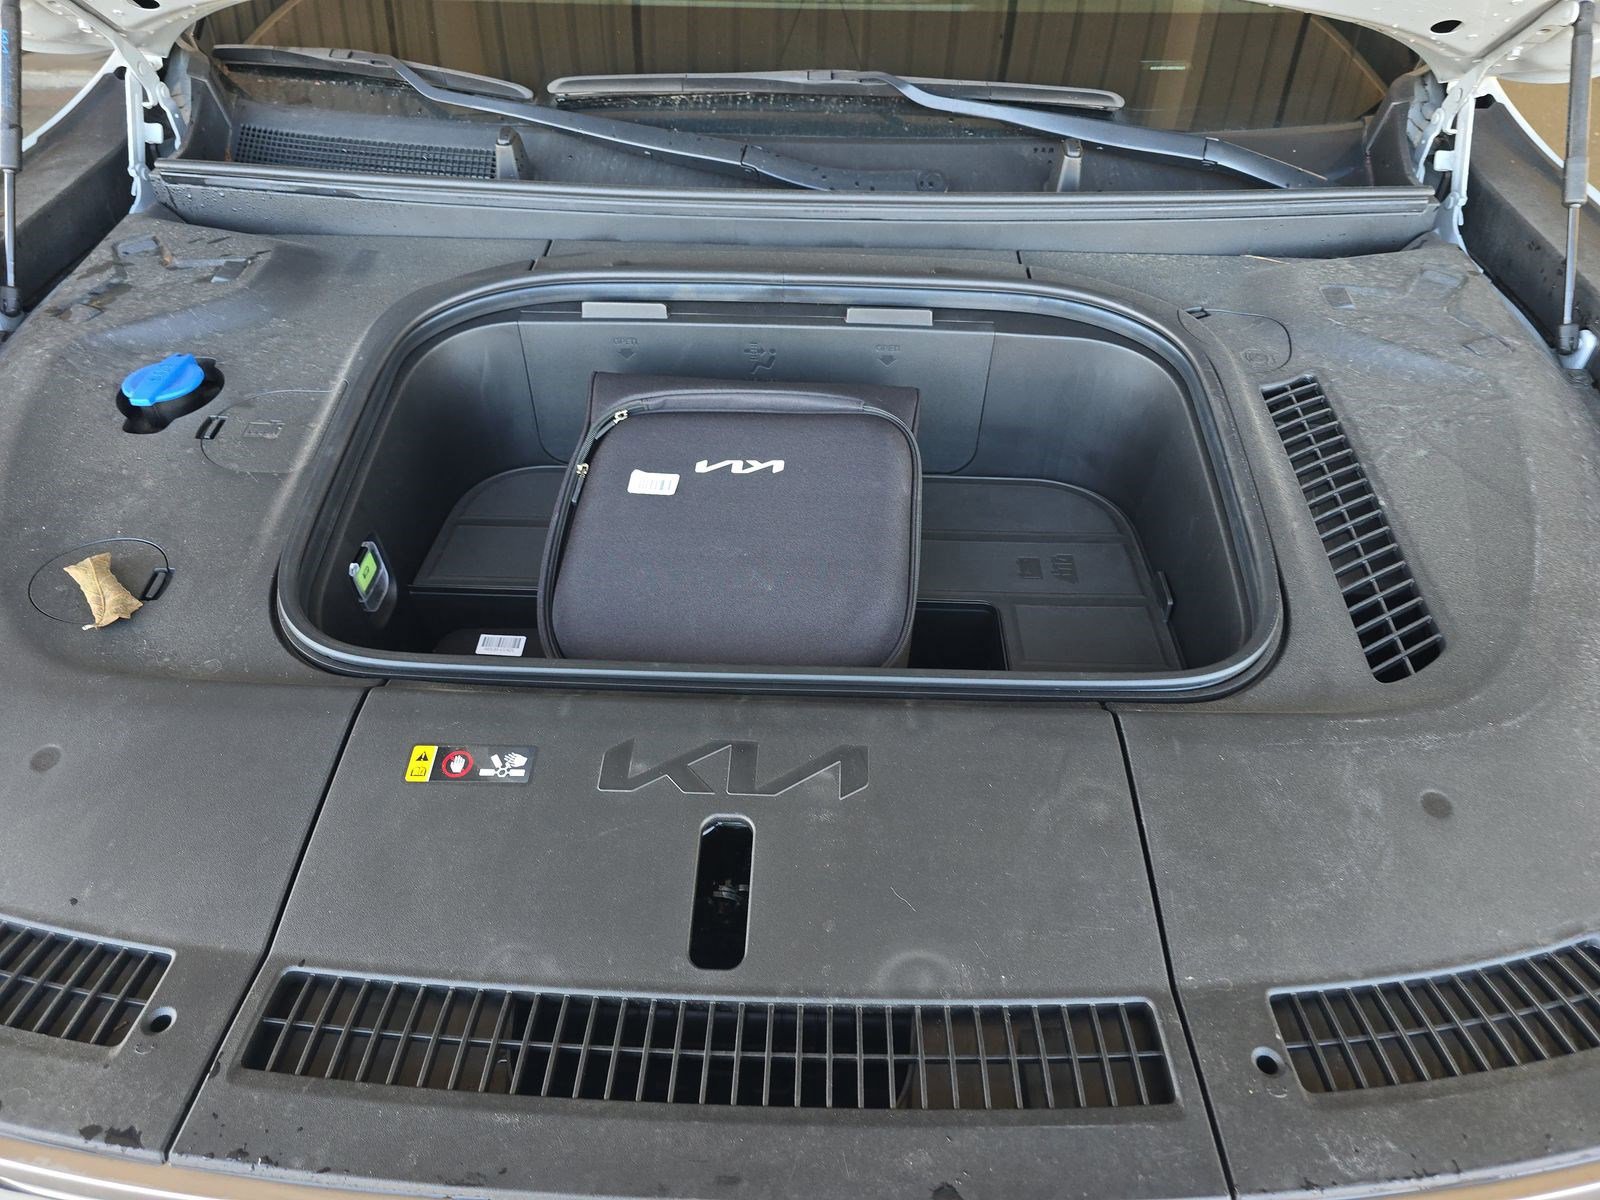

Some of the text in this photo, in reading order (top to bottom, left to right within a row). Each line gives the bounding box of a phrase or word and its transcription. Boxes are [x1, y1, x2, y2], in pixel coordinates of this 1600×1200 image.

[613, 336, 639, 345] OPEN
[874, 343, 901, 352] OPEN
[695, 460, 785, 474] KIA
[597, 739, 869, 799] KIA
